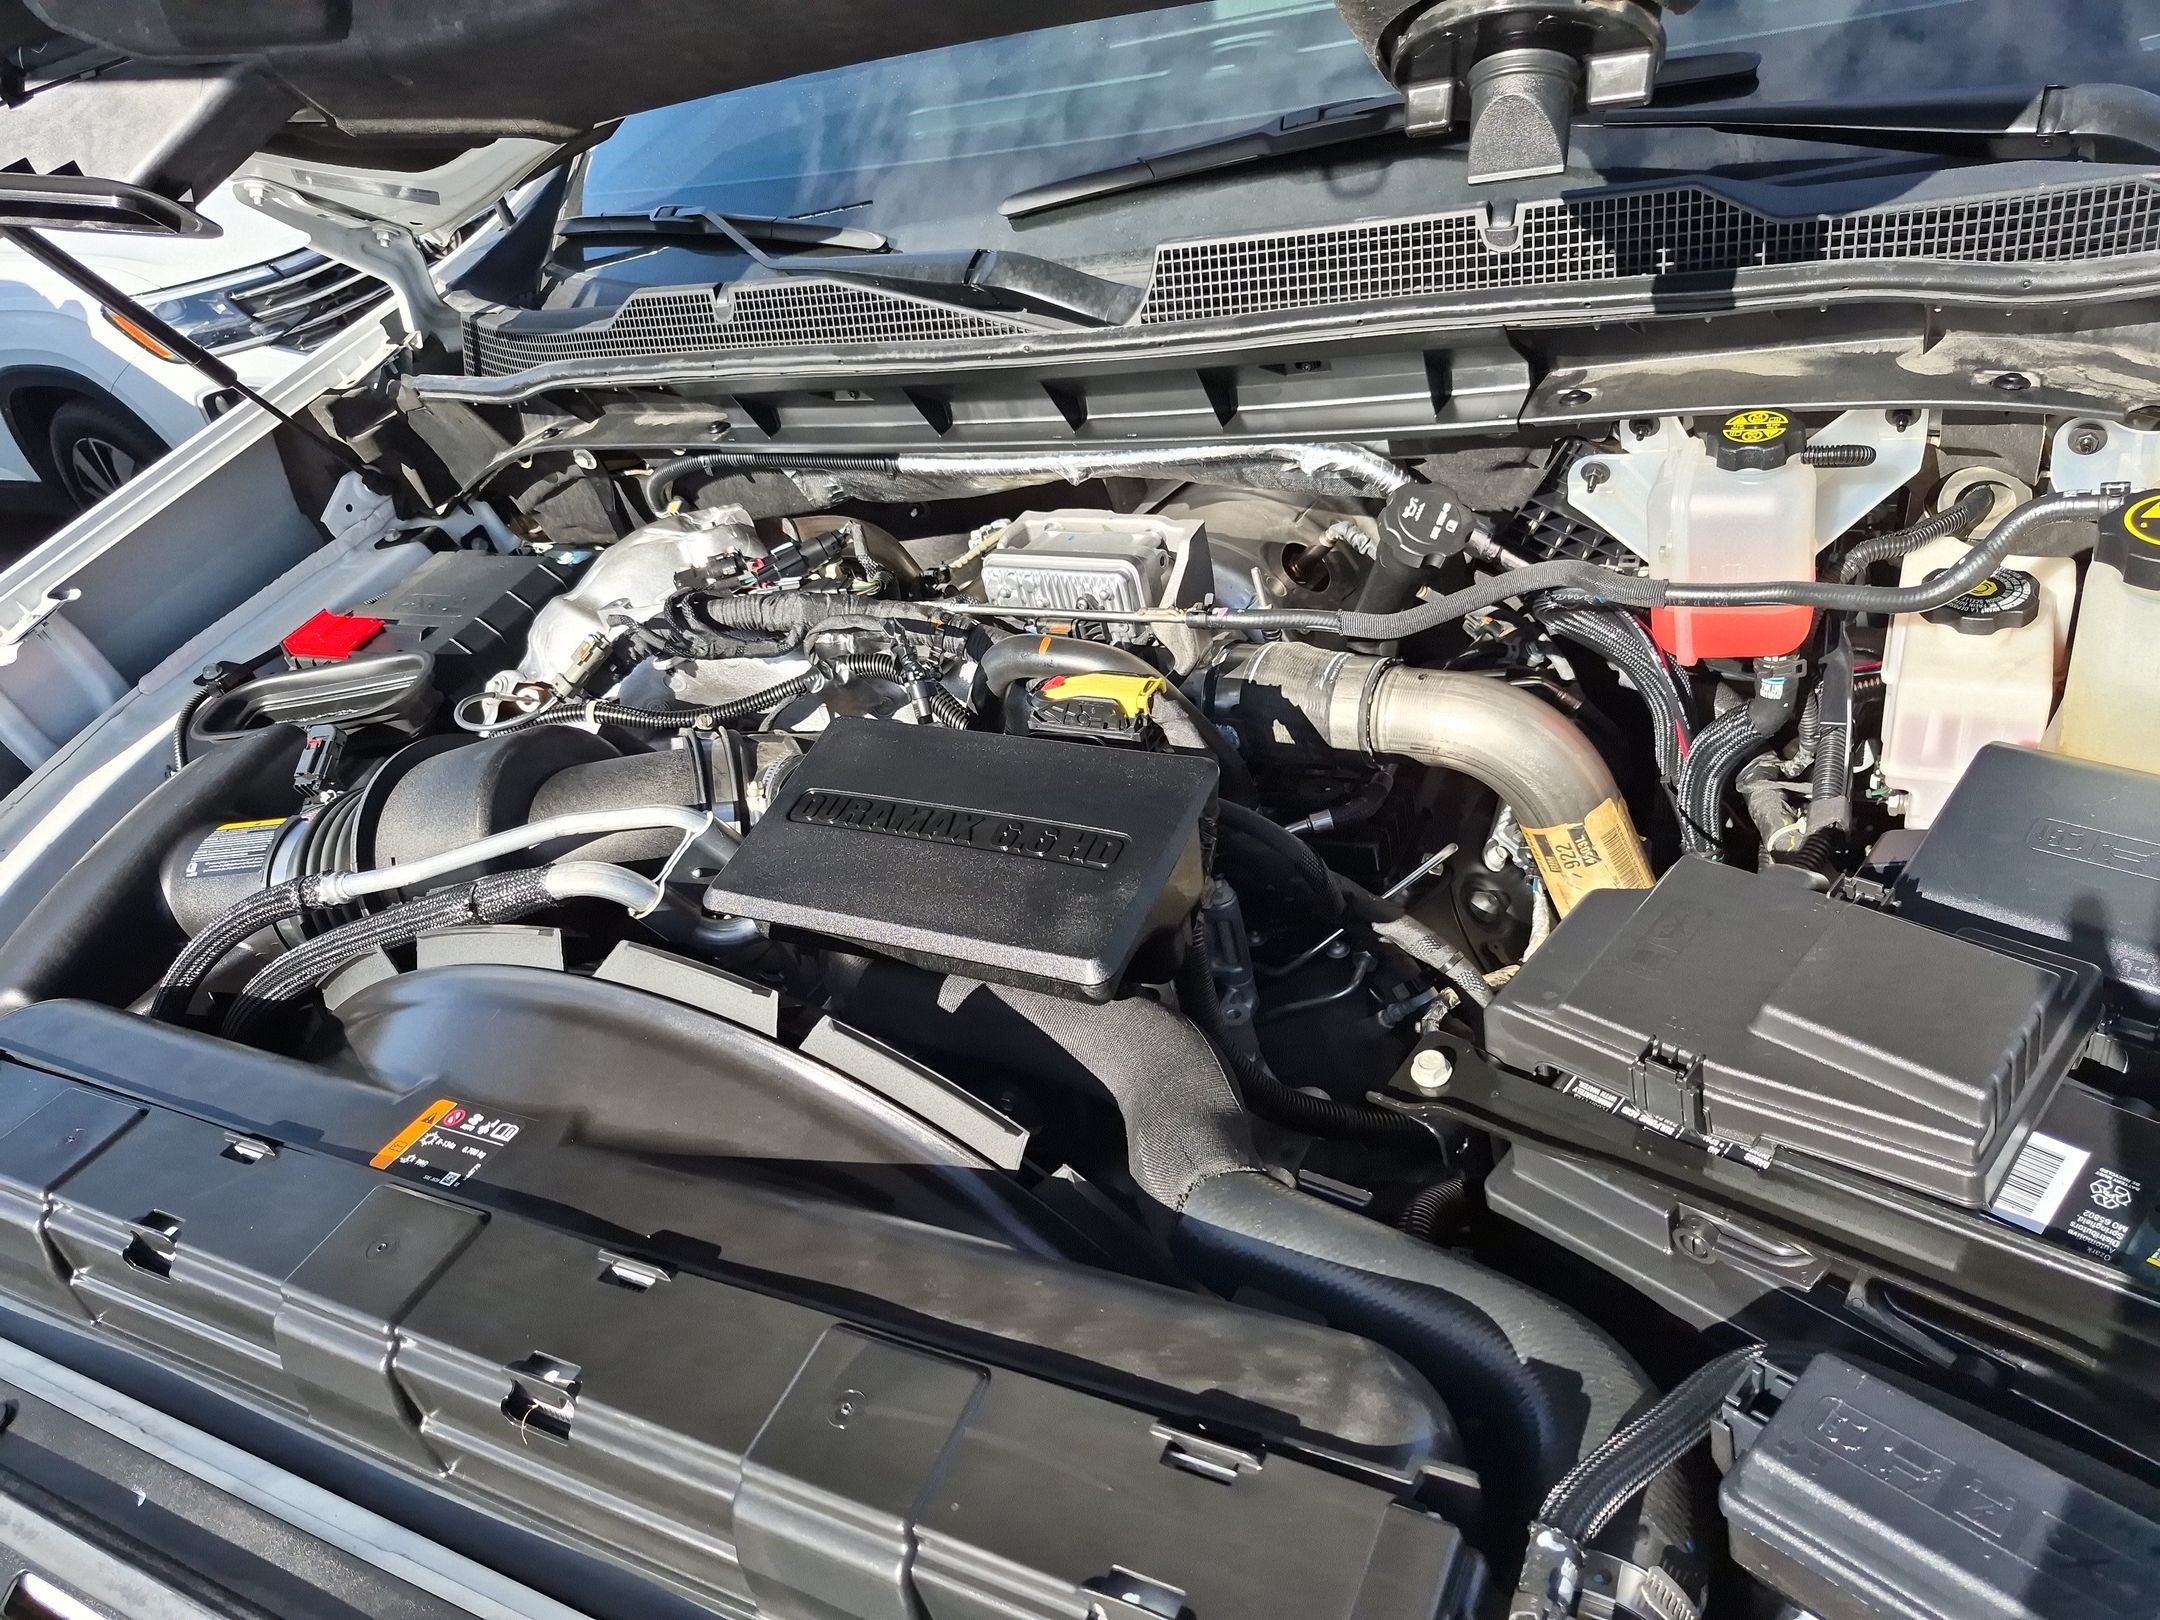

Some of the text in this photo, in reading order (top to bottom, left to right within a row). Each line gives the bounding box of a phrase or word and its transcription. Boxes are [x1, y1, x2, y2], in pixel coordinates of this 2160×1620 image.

[801, 794, 1125, 869] DURAMAX 6.6 HD
[1555, 842, 1581, 869] 922
[1599, 1088, 1618, 1103] WITH
[1620, 1106, 1643, 1119] ACID
[2113, 1176, 2141, 1192] BATTERY
[2082, 1209, 2129, 1234] MO 65802
[2067, 1228, 2116, 1255] Automotive
[2069, 1221, 2121, 1248] Distributors
[2087, 1246, 2112, 1262] Ozark
